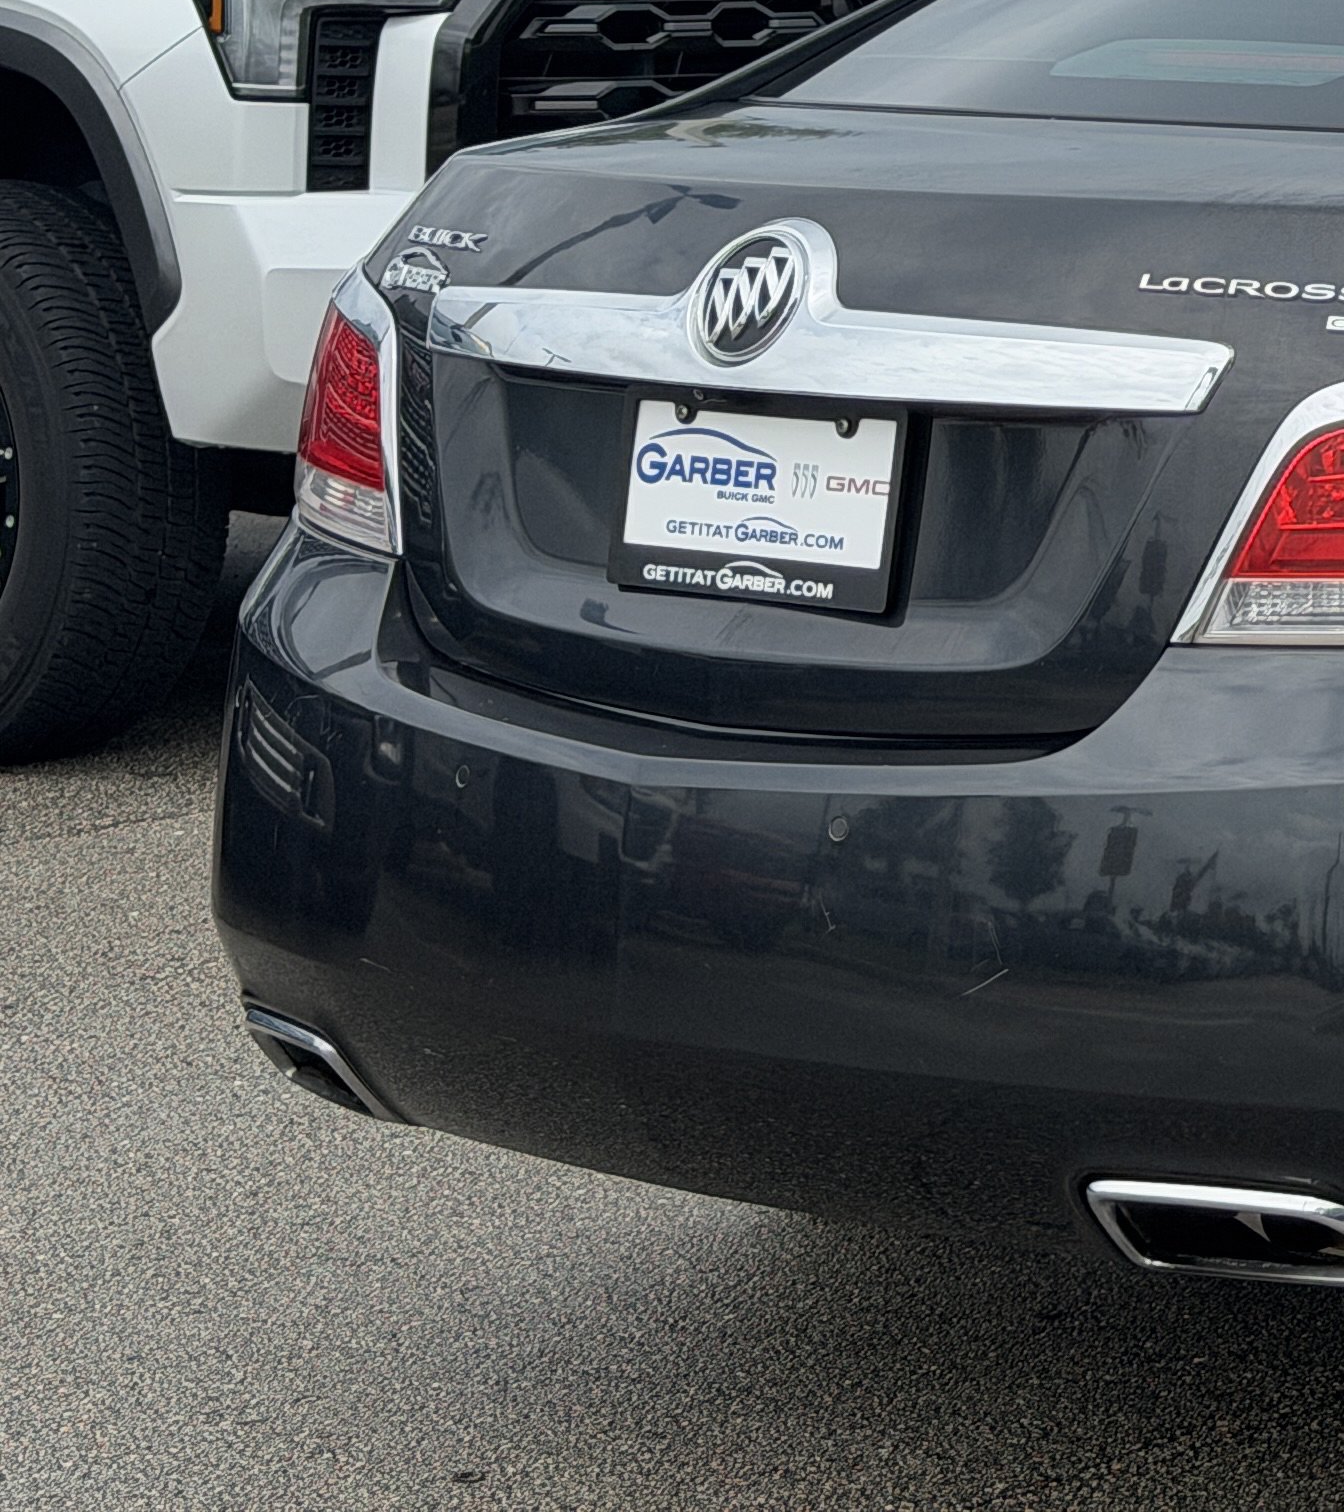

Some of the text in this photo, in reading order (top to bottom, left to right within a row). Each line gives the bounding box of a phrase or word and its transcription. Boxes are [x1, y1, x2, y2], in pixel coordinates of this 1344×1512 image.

[408, 225, 488, 252] BUICK
[636, 442, 777, 491] GARBER
[716, 490, 775, 504] BUICK GMC
[826, 475, 890, 496] GMC
[666, 519, 844, 551] GETITATGARBER.COM
[643, 563, 834, 600] GETITATGARBER.COM
